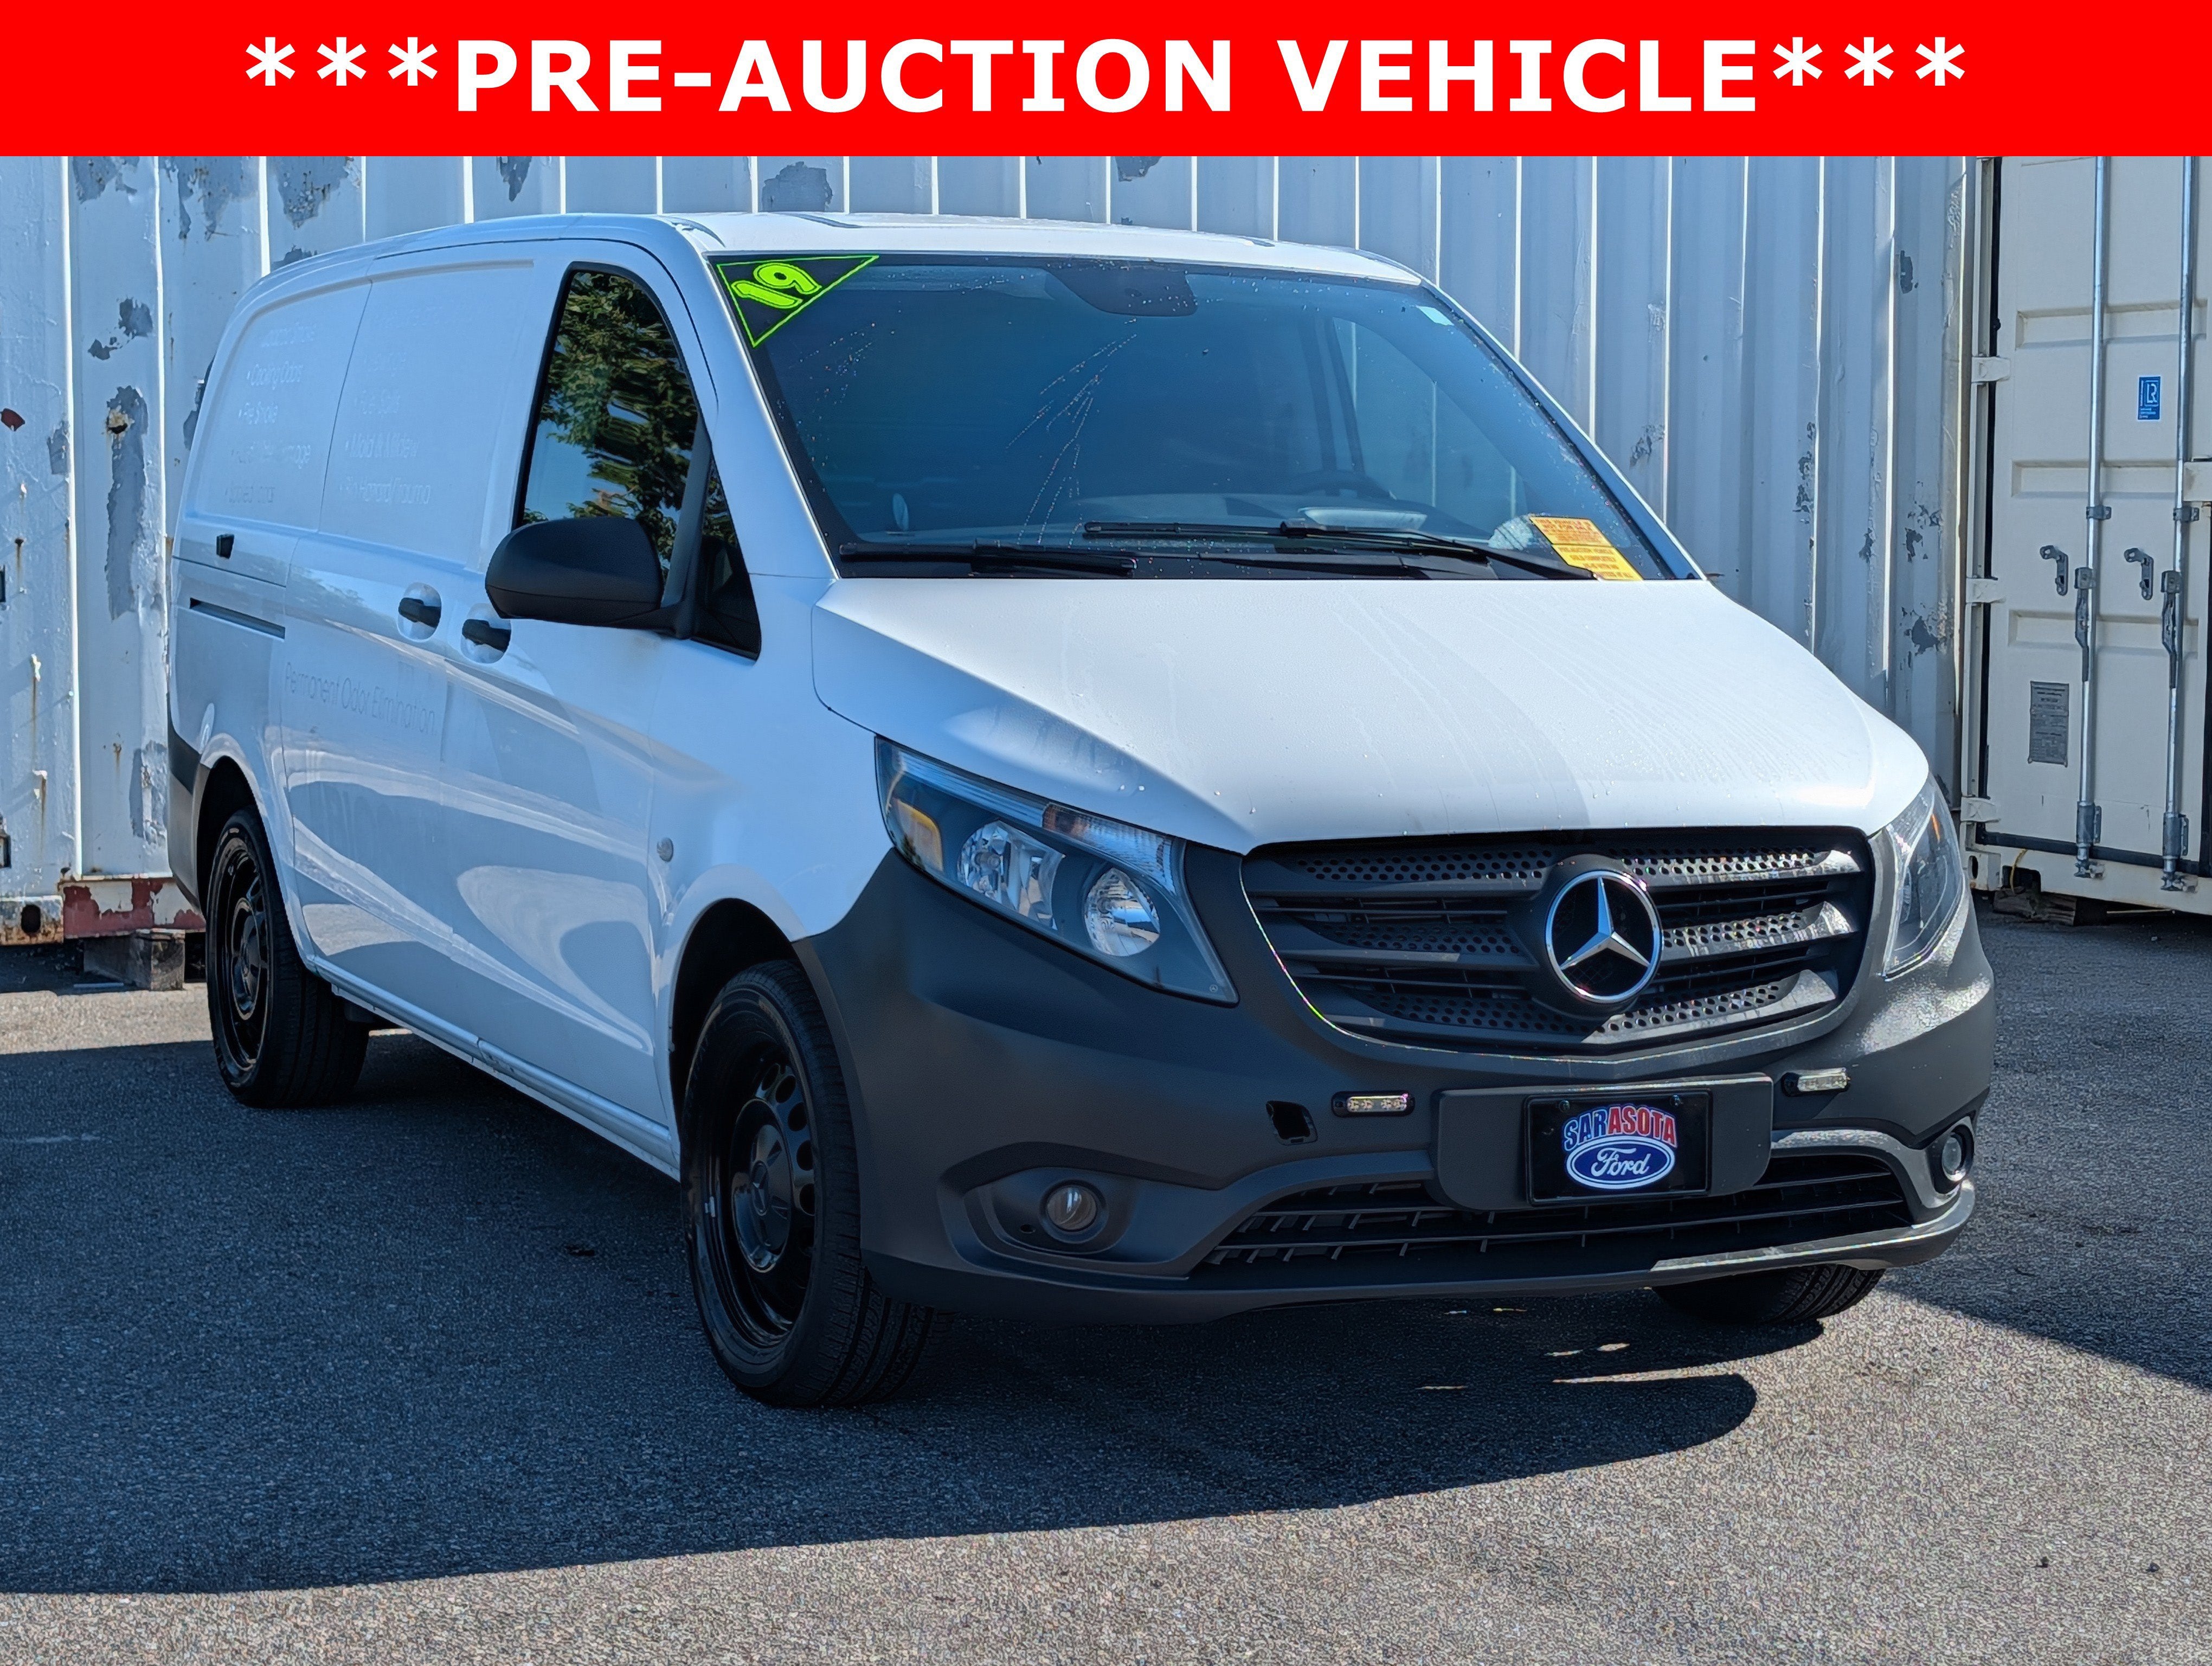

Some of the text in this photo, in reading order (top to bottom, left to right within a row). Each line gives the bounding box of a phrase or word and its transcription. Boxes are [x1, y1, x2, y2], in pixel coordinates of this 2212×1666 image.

[731, 262, 822, 309] 19
[1564, 1105, 1677, 1151] SARASOTA
[1591, 1148, 1652, 1177] Ford
